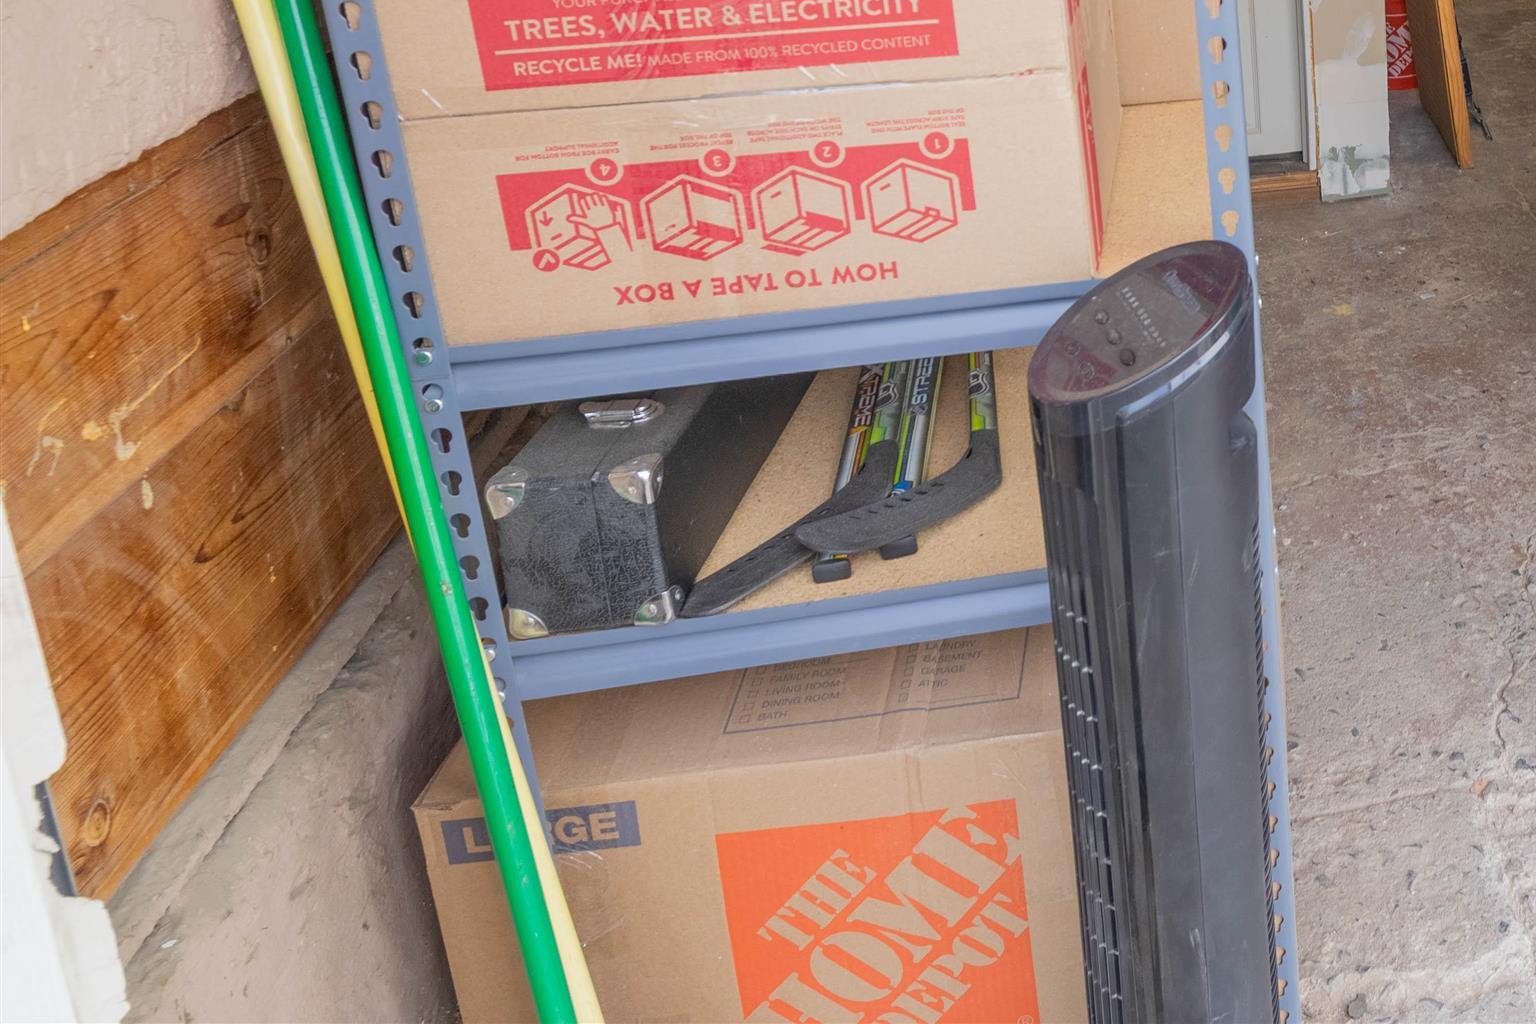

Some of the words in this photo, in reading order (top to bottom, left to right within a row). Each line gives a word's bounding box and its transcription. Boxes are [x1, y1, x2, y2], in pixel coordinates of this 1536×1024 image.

[504, 13, 606, 42] TREES,
[609, 5, 714, 34] WATER
[721, 3, 743, 26] &
[513, 56, 604, 77] RECYCLE
[606, 52, 643, 71] ME!
[647, 49, 693, 67] MADE
[695, 46, 741, 64] FROM
[743, 44, 779, 60] 100%
[781, 38, 859, 56] RECYCLED
[861, 33, 932, 52] CONTENT
[822, 146, 833, 158] 2
[932, 138, 942, 150] 1
[599, 162, 612, 175] 4
[711, 154, 723, 167] 3
[784, 267, 823, 289] TO
[832, 260, 899, 284] HOW
[613, 281, 676, 306] BOX
[681, 279, 703, 299] A
[712, 272, 779, 296] TAPE
[911, 357, 934, 406] STREE
[922, 651, 982, 663] BASEMENT
[768, 671, 812, 685] FAMILY
[814, 666, 847, 680] ROOM
[920, 663, 967, 676] GARAGE
[764, 684, 801, 697] LIVING
[805, 679, 840, 693] ROOM
[917, 678, 949, 689] ATTIC
[761, 696, 801, 709] DINING
[805, 692, 840, 705] ROOM
[756, 710, 789, 722] BATH
[462, 810, 621, 855] LGE
[756, 848, 879, 952] THE
[744, 805, 1022, 1024] HOME
[872, 894, 1029, 1024] DEPOT
